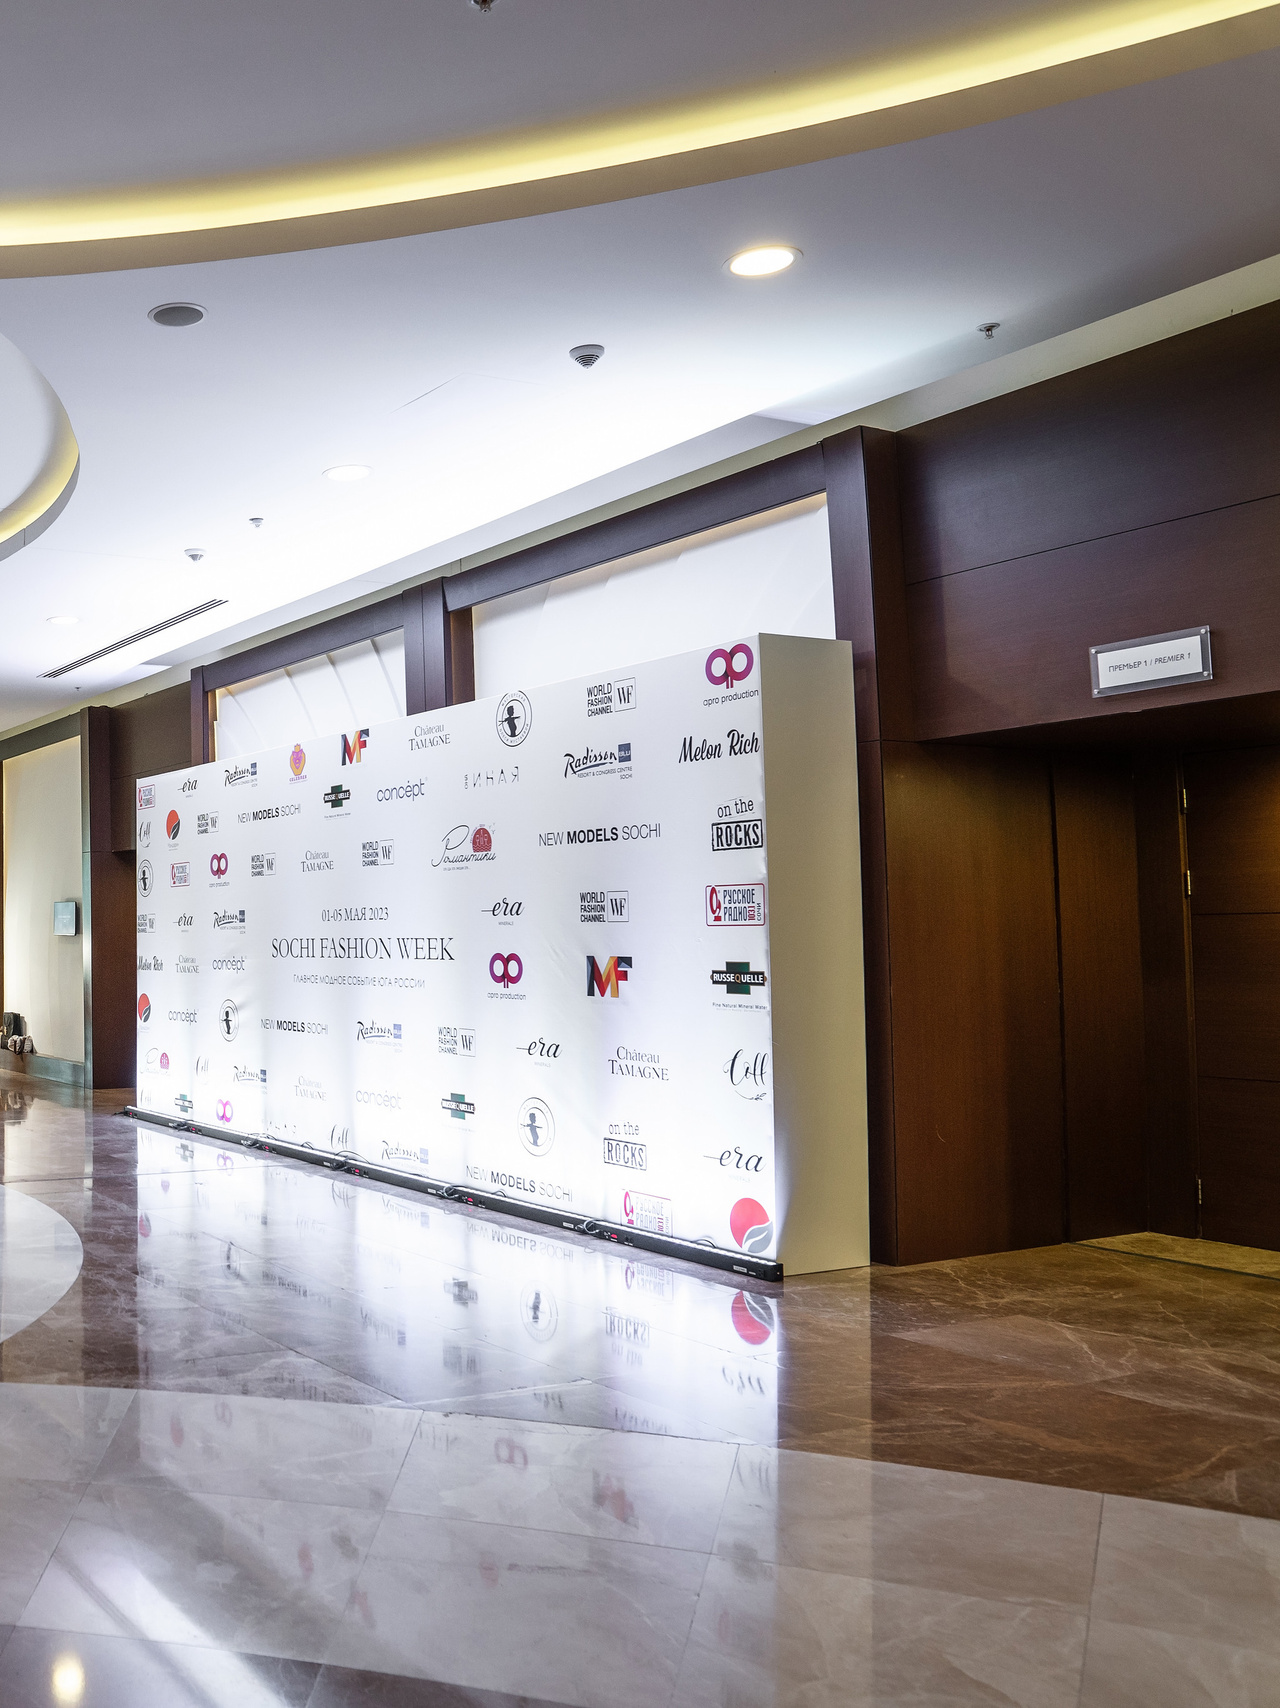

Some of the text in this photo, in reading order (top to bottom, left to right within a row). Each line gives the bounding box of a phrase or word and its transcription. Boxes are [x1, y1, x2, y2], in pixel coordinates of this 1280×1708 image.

[1108, 661, 1142, 673] ПРЕМЬЕР
[1154, 653, 1185, 665] PREMIER
[587, 683, 613, 698] WORLD
[703, 689, 760, 707] apro production
[587, 695, 613, 708] FASHION
[587, 705, 613, 717] CHANNEL
[408, 734, 451, 751] TAMAGNE
[678, 729, 761, 764] Melon Rich
[563, 746, 617, 779] Radisson
[224, 764, 251, 787] Radisson
[177, 778, 198, 792] era
[237, 803, 301, 824] NEW MODELS SOCHI
[717, 798, 754, 819] on the
[538, 823, 661, 847] NEW MODELS SOCHI
[715, 823, 761, 849] ROCKS
[361, 841, 379, 851] WORLD
[251, 854, 264, 863] WORLD
[361, 851, 379, 859] FASHION
[362, 859, 379, 867] CHANNEL
[301, 860, 334, 873] TAMAGNE
[580, 891, 606, 904] WORLD
[723, 888, 756, 905] РУССКОЕ
[321, 906, 390, 922] 01-05 МАЯ 2023
[482, 897, 525, 917] era
[580, 903, 606, 913] FASHION
[609, 897, 626, 916] WF
[173, 913, 194, 927] era
[213, 909, 239, 929] Radisson
[580, 913, 606, 923] CHANNEL
[271, 937, 455, 961] SOCHI FASHION WEEK
[175, 963, 200, 974] TAMAGNE
[394, 977, 426, 989] РОССИИ
[713, 972, 764, 984] RUSSEQUELLE
[500, 991, 527, 1001] production
[261, 1018, 329, 1036] NEW MODELS SOCHI
[356, 1019, 393, 1041] Radisson
[438, 1026, 458, 1038] WORLD
[517, 1037, 563, 1059] era
[616, 1045, 660, 1064] Château
[608, 1058, 670, 1082] TAMAGNE
[608, 1121, 640, 1136] on the
[607, 1141, 644, 1168] ROCKS
[704, 1146, 768, 1173] era
[465, 1165, 573, 1202] NEW MODELS SOCHI
